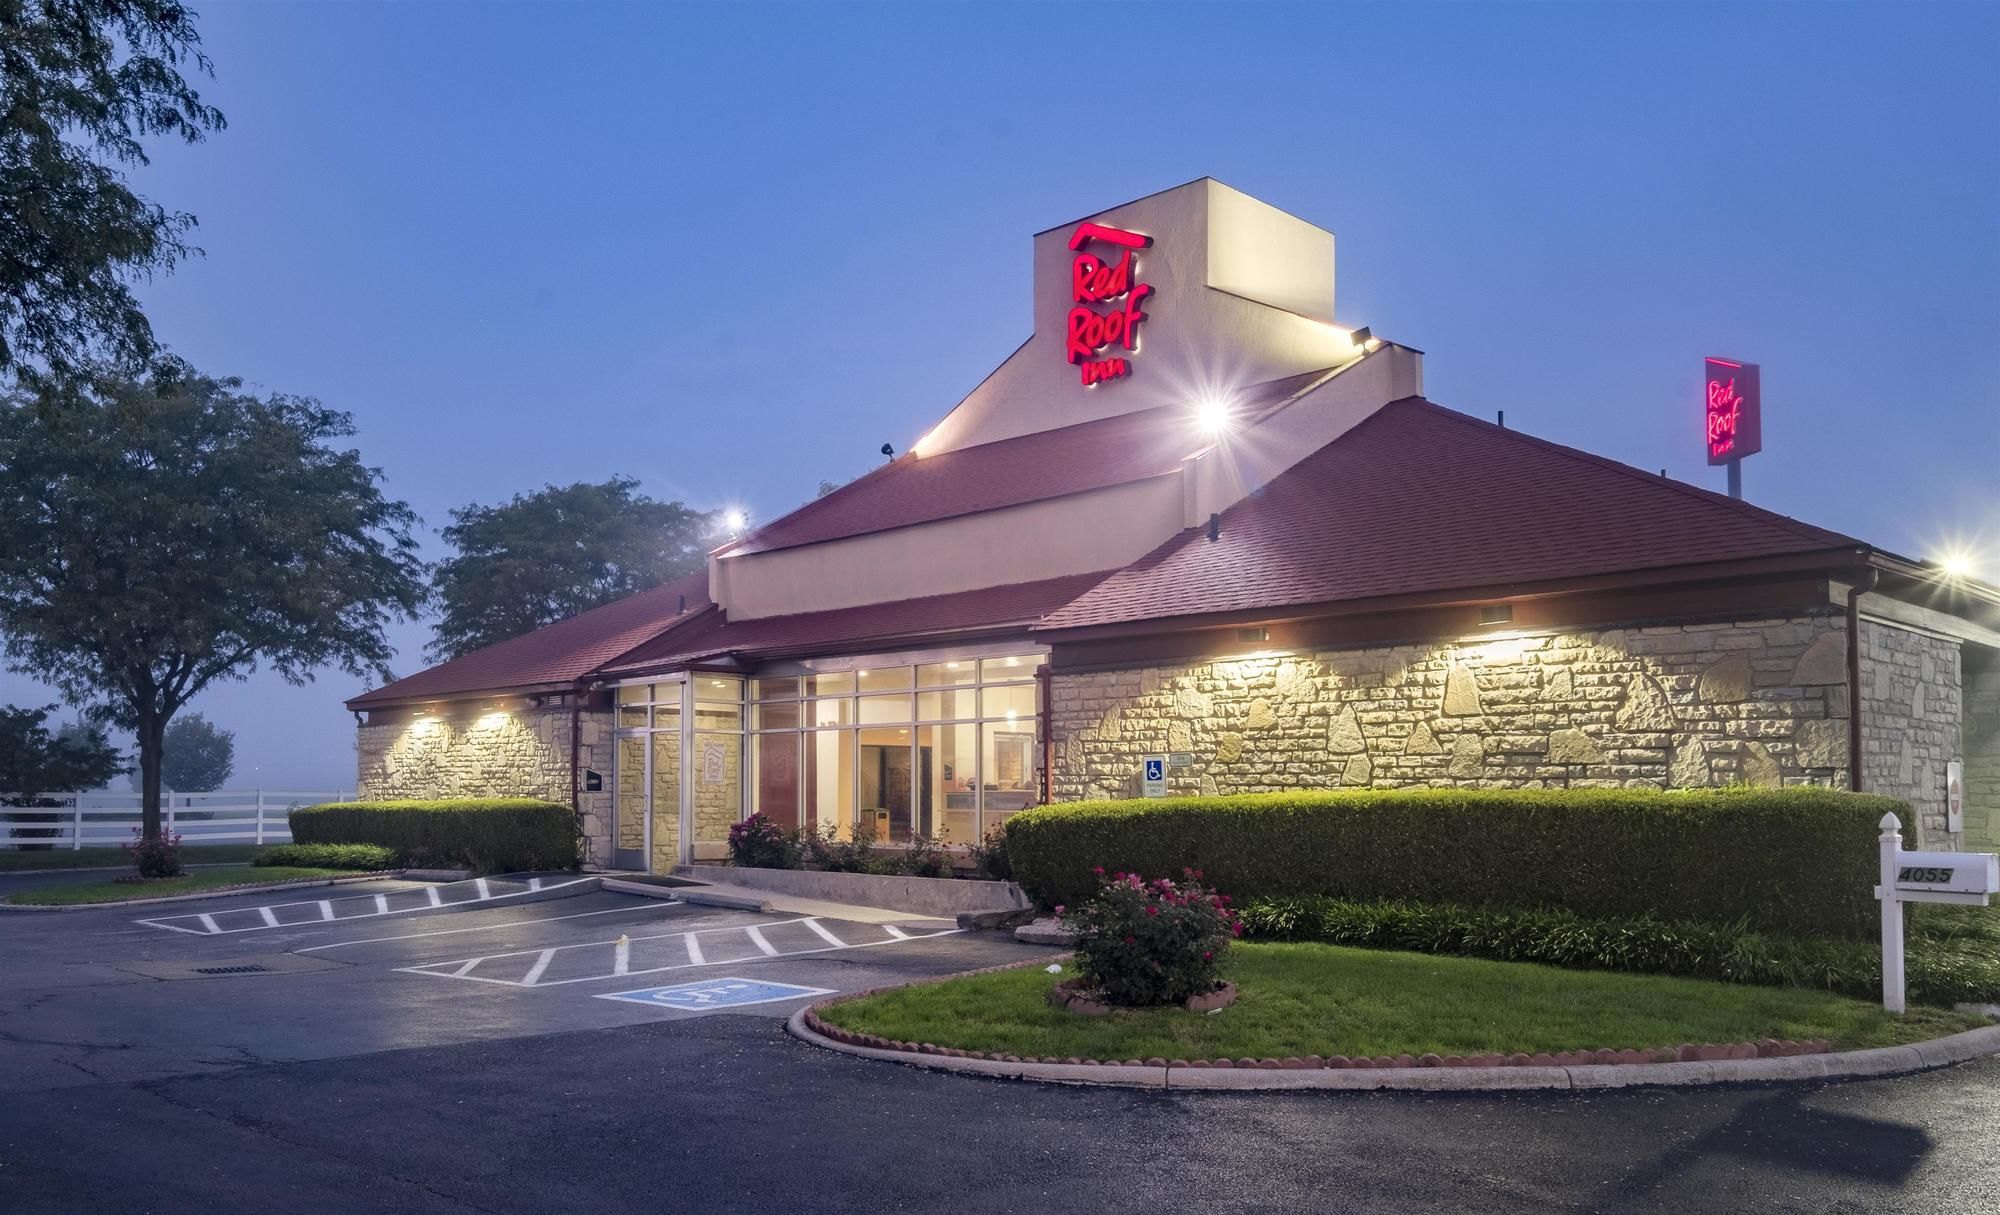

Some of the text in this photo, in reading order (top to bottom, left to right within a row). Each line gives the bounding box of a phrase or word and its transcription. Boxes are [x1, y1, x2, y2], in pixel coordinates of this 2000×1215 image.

[1073, 250, 1132, 303] Red
[1067, 284, 1150, 364] Roof
[1082, 358, 1126, 385] Inn
[1708, 378, 1735, 409] Red
[1708, 397, 1743, 444] Roof
[1899, 867, 1953, 882] 4055
